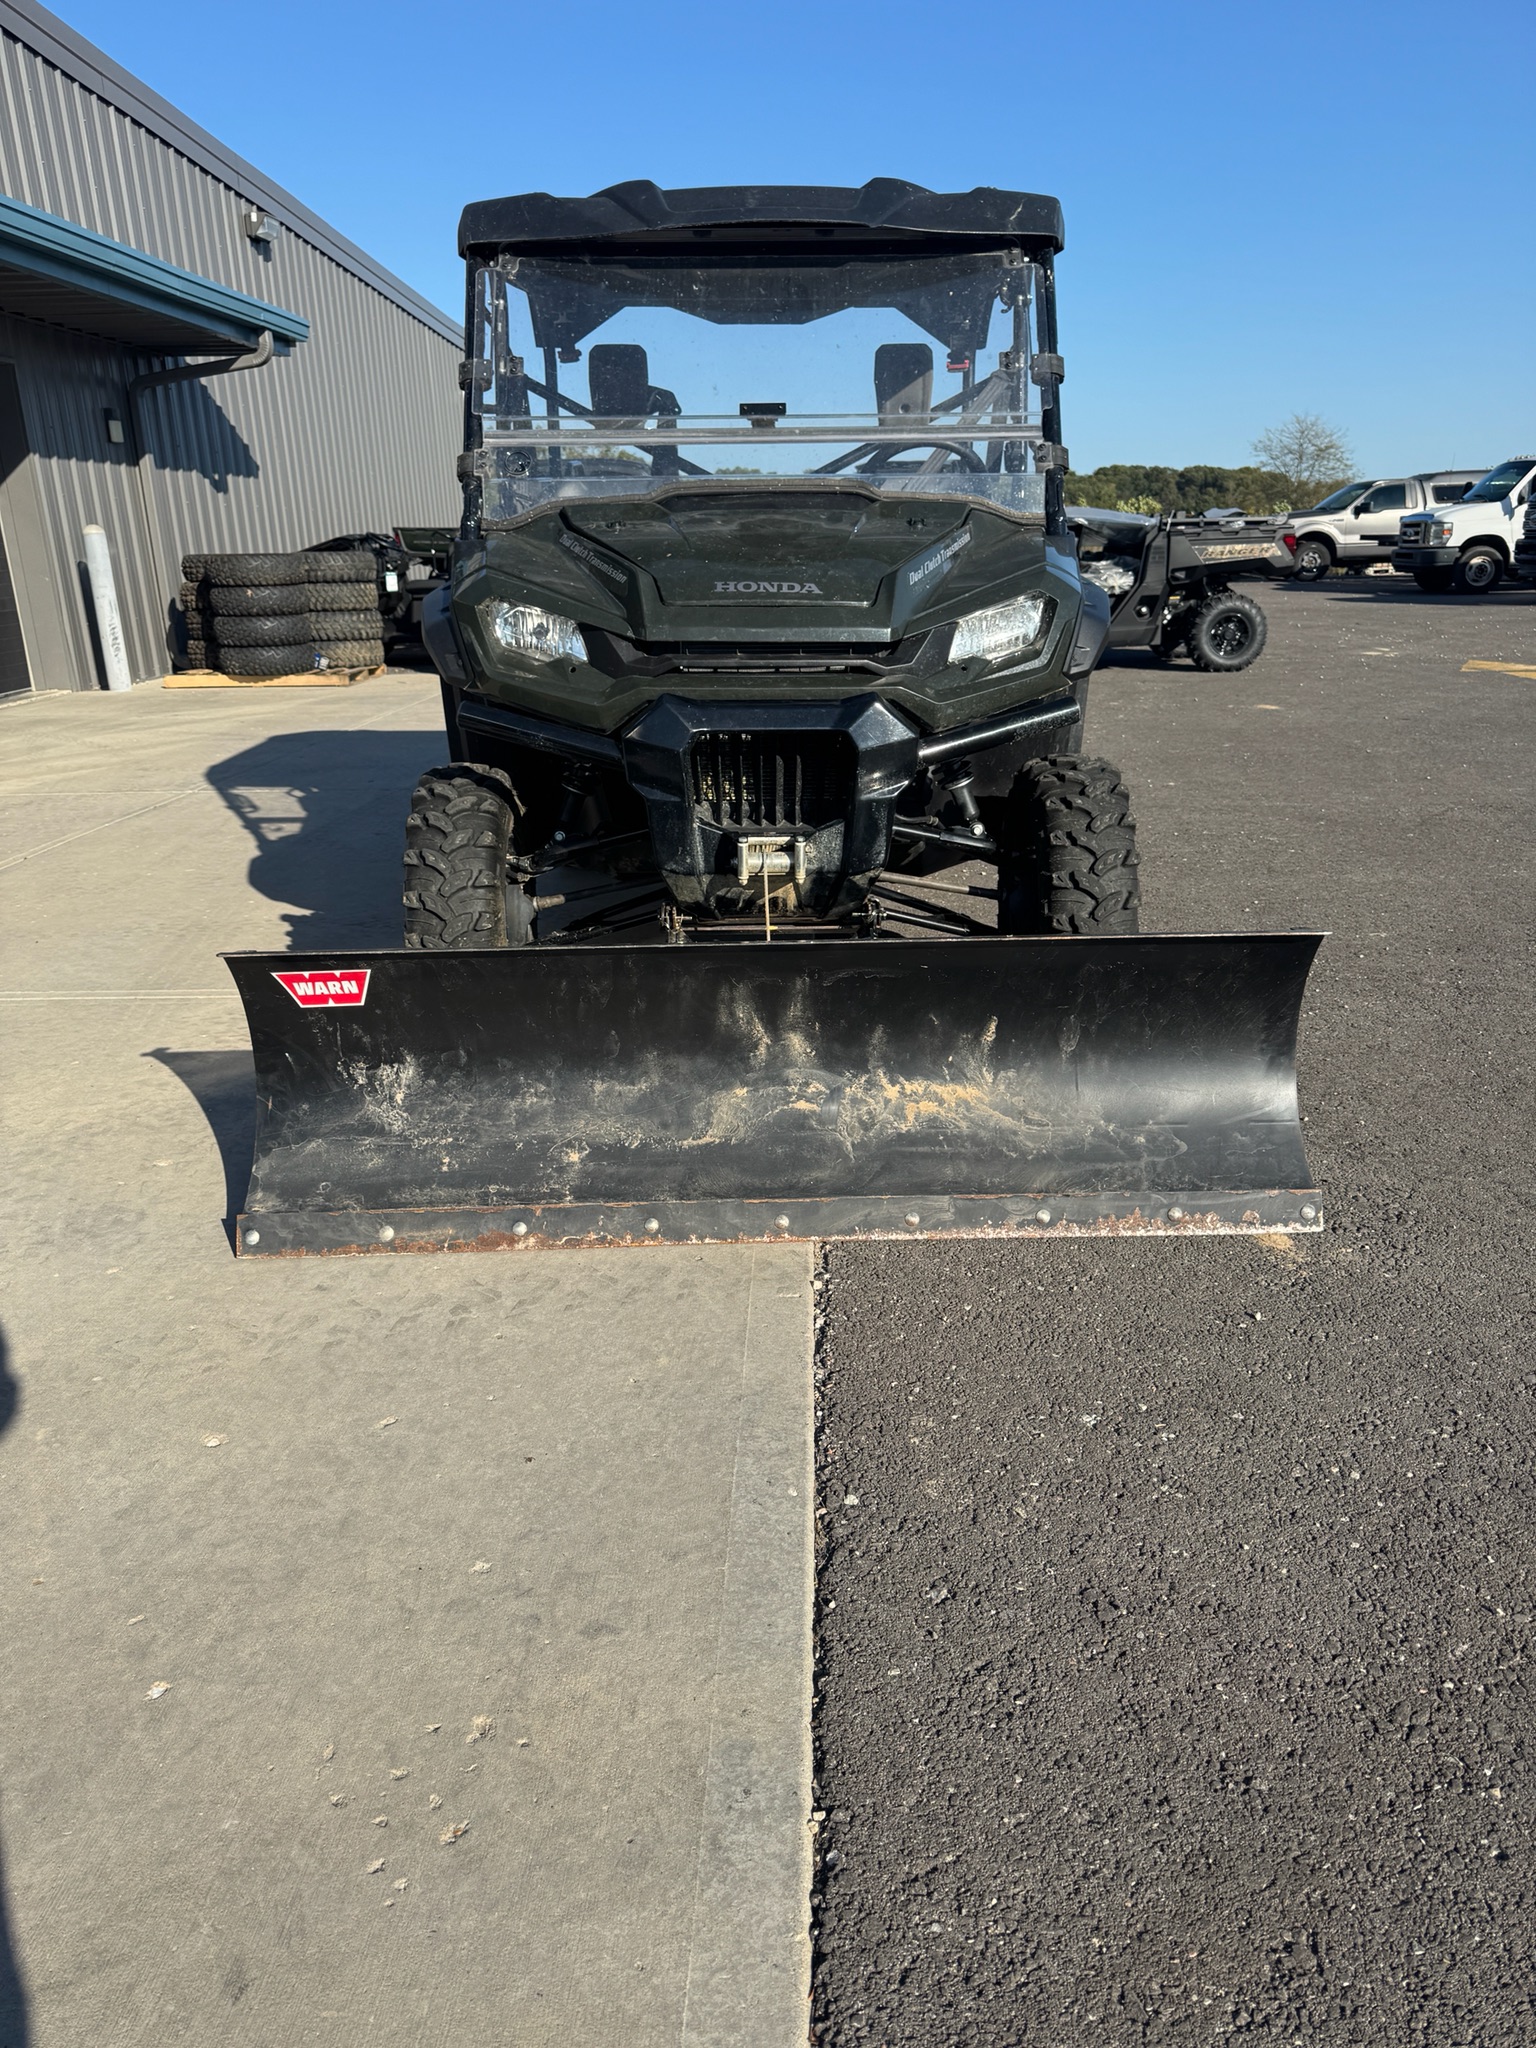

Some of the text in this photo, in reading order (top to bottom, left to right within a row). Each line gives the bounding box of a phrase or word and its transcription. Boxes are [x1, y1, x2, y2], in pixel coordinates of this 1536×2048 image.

[909, 565, 924, 586] Dual
[940, 532, 971, 562] Transmission
[1201, 546, 1271, 559] RANGER
[586, 551, 628, 584] Transmission
[714, 581, 824, 594] HONDA
[292, 980, 360, 996] WARN
